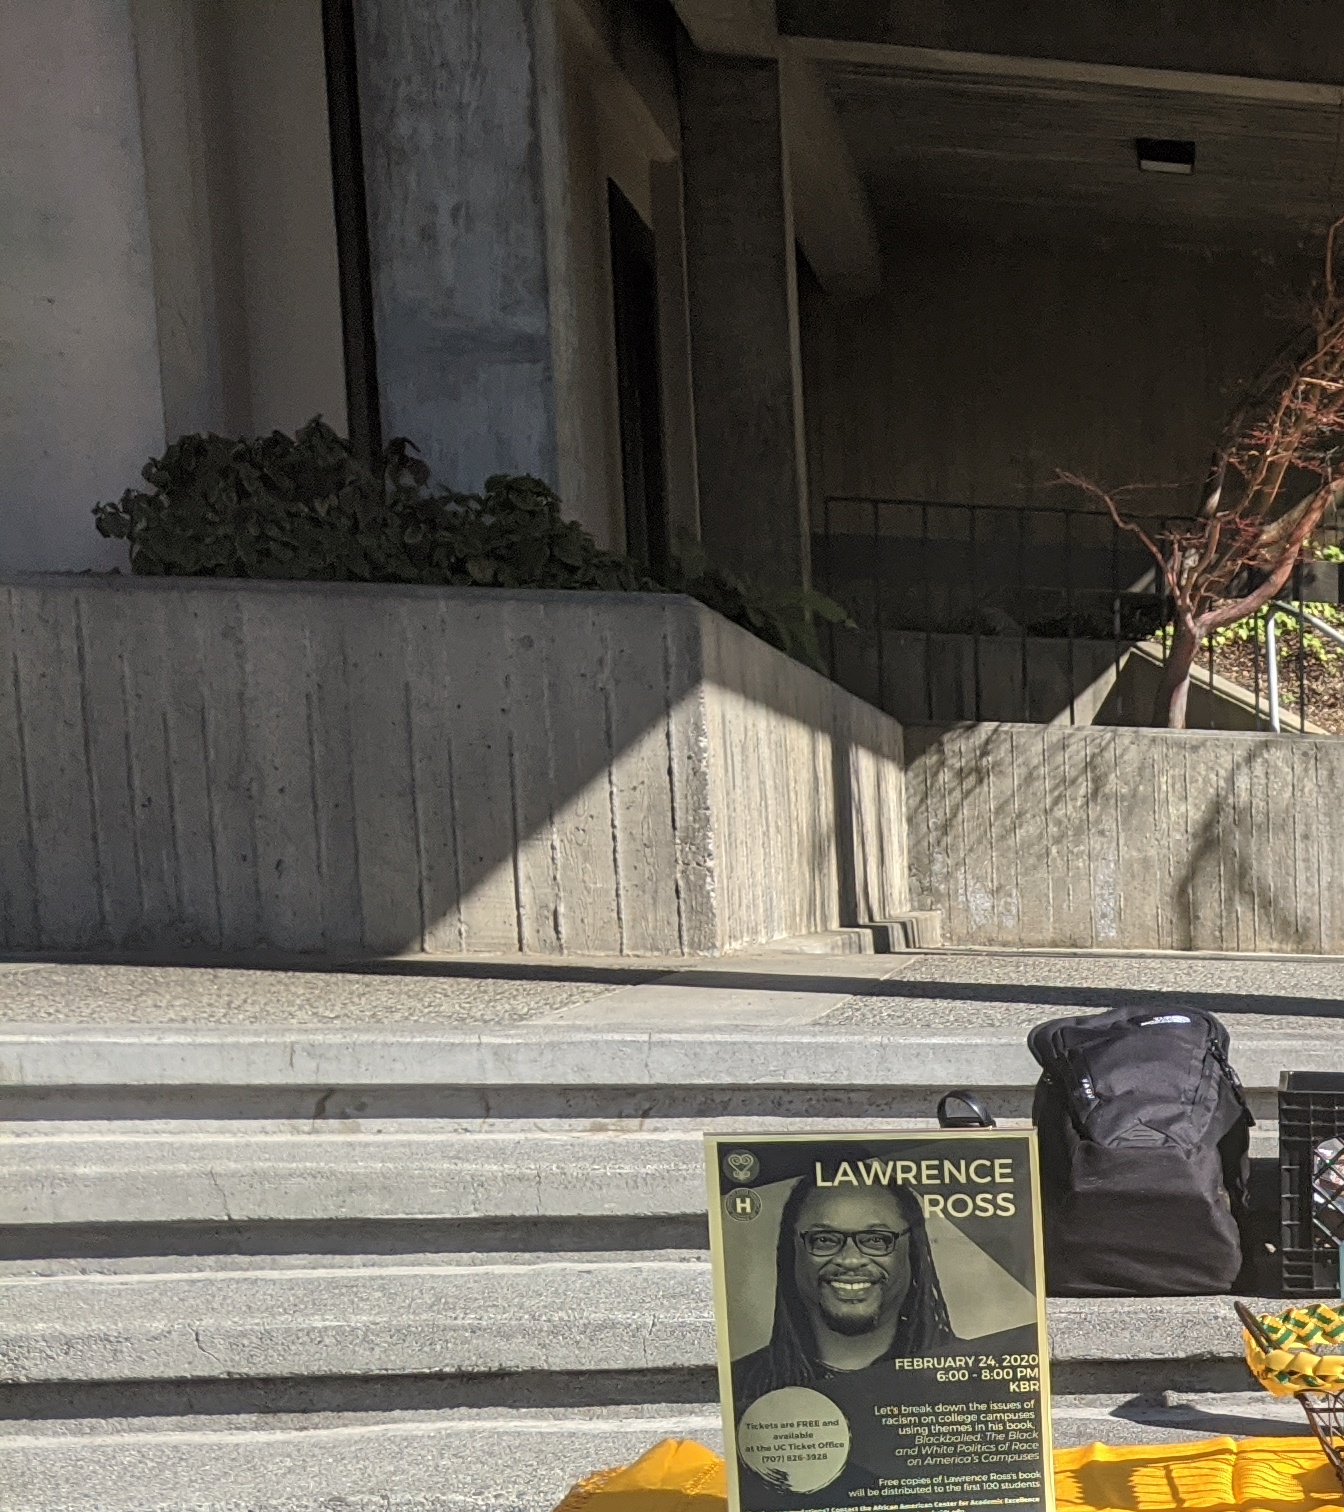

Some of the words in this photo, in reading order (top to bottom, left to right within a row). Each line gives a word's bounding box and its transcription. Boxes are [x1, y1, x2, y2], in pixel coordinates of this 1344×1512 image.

[815, 1158, 1014, 1187] LAWRENCE
[735, 1197, 752, 1214] H
[923, 1192, 1016, 1218] ROSS
[895, 1356, 975, 1370] FEBRUARY
[1002, 1354, 1039, 1366] 2020
[936, 1369, 969, 1382] 6:00
[981, 1368, 1013, 1380] 8:00
[1017, 1367, 1039, 1379] PM
[1009, 1380, 1040, 1392] KBR
[874, 1405, 898, 1416] Let's
[901, 1403, 932, 1414] break
[935, 1402, 966, 1412] down
[969, 1401, 987, 1411] the
[990, 1400, 1021, 1410] issues
[1023, 1399, 1035, 1410] of
[746, 1422, 778, 1430] Tickets
[796, 1420, 820, 1428] FREE
[822, 1419, 839, 1427] and
[882, 1415, 918, 1425] racism
[921, 1415, 936, 1424] on
[938, 1412, 978, 1424] college
[980, 1411, 1035, 1422] campuses
[773, 1431, 814, 1440] available
[898, 1424, 928, 1436] using
[931, 1423, 972, 1433] themes
[975, 1422, 985, 1432] in
[988, 1421, 1003, 1431] his
[915, 1434, 983, 1445] Blackballed:
[985, 1432, 1005, 1441] The
[1008, 1430, 1039, 1440] Black
[756, 1444, 771, 1452] the
[788, 1442, 816, 1450] Ticket
[817, 1441, 844, 1449] Office
[895, 1446, 918, 1456] and
[921, 1445, 954, 1455] White
[957, 1442, 996, 1453] Politics
[998, 1442, 1010, 1452] of
[1012, 1441, 1039, 1451] Race
[761, 1455, 785, 1463] (707)
[907, 1458, 922, 1467] on
[923, 1454, 979, 1466] America's
[981, 1451, 1040, 1464] Campuses
[878, 1477, 899, 1487] Free
[900, 1477, 931, 1488] copies
[932, 1475, 943, 1485] of
[944, 1474, 988, 1484] Lawrence
[990, 1472, 1017, 1481] Ross's
[1018, 1471, 1041, 1480] book
[848, 1488, 865, 1498] will
[867, 1488, 878, 1497] be
[881, 1485, 932, 1496] distributed
[934, 1485, 944, 1493] to
[946, 1484, 962, 1493] the
[963, 1482, 981, 1492] first
[983, 1481, 999, 1491] 100
